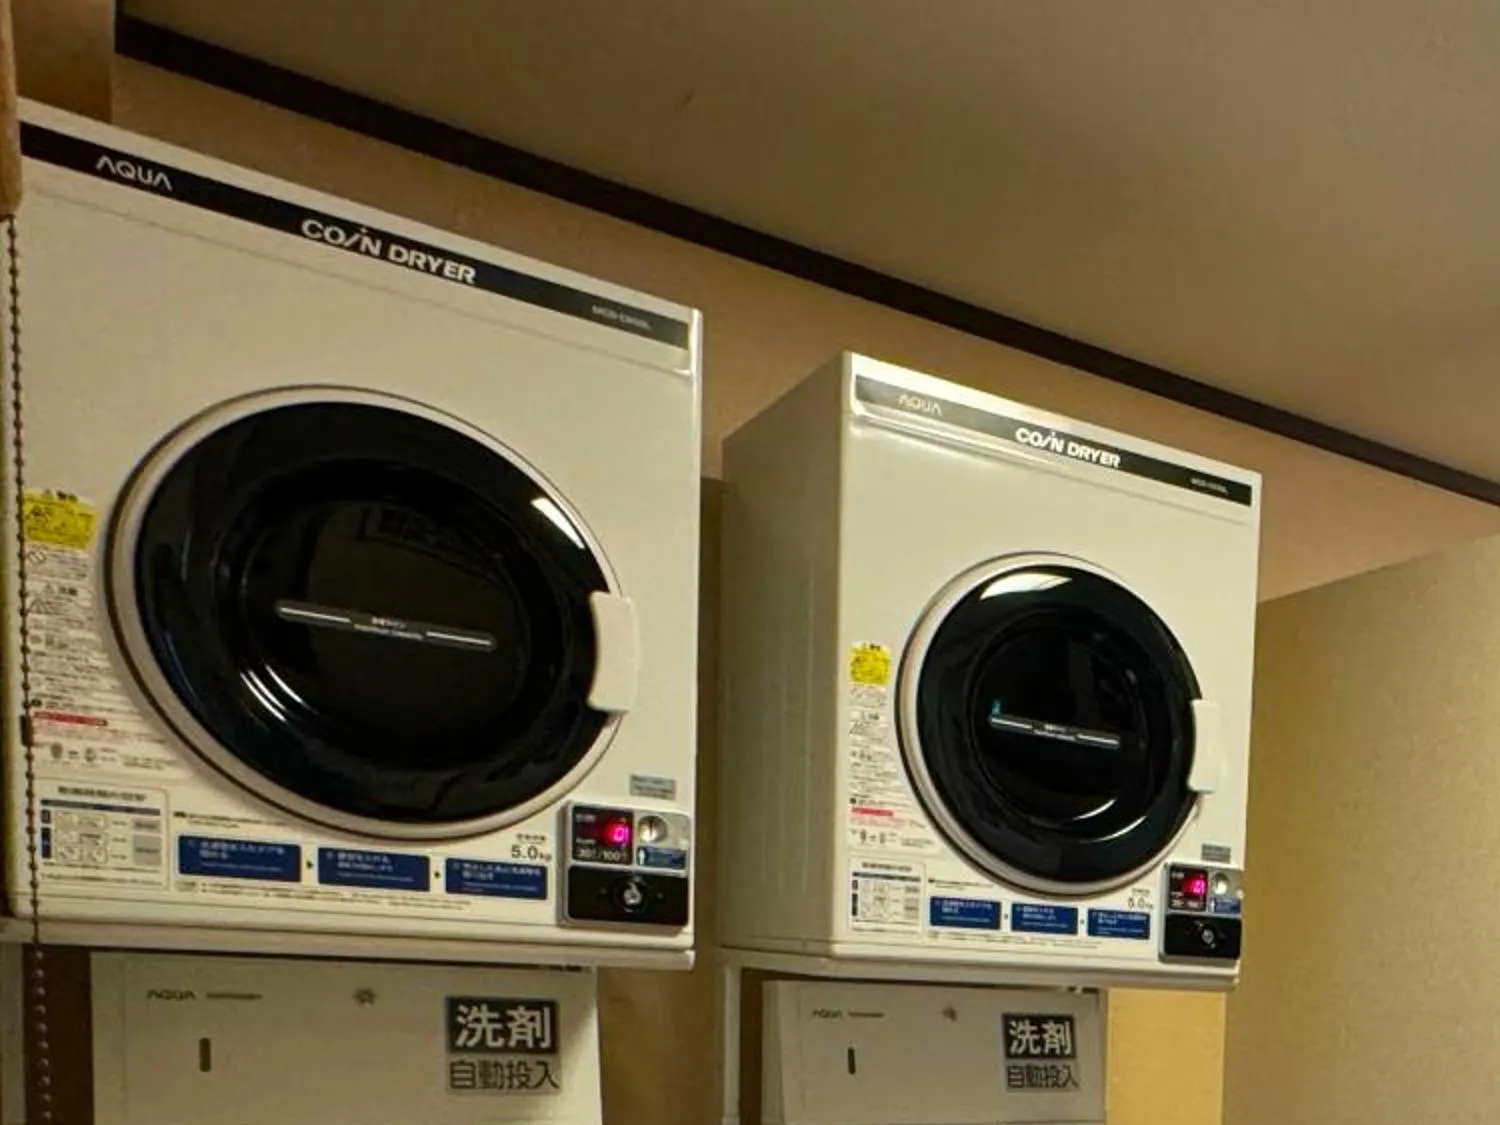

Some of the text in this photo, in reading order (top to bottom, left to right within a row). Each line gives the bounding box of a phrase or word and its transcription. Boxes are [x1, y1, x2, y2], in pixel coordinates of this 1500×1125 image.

[97, 154, 172, 192] AQUA
[388, 242, 477, 285] DRYER
[898, 392, 943, 417] AQUA
[1066, 442, 1121, 469] DRYER
[146, 989, 196, 1001] AQUA
[455, 1003, 553, 1049] 洗剤
[1009, 1019, 1072, 1056] 洗剤
[449, 1060, 561, 1091] 自動投入
[1006, 1064, 1079, 1089] 自動投入
